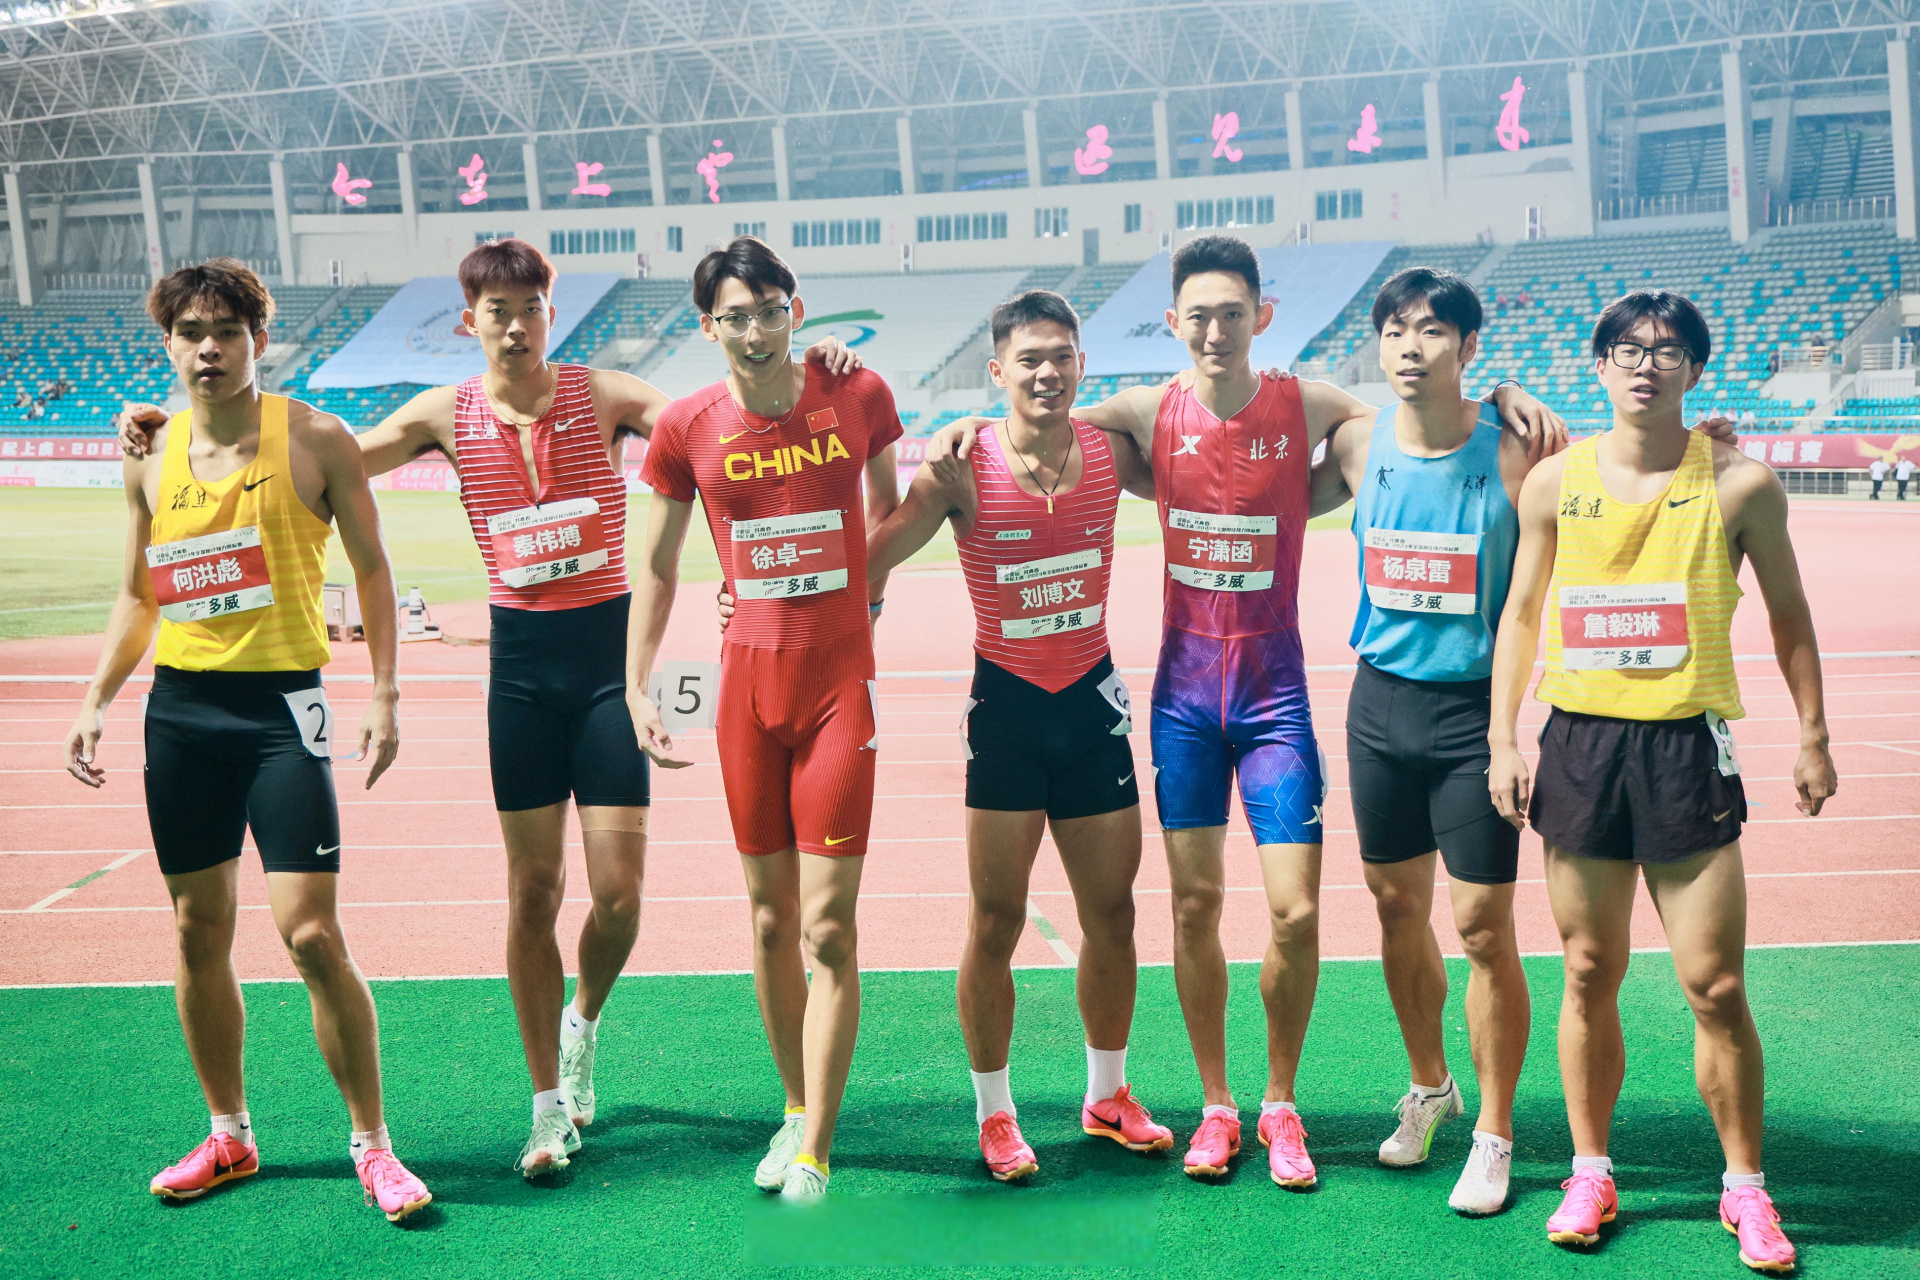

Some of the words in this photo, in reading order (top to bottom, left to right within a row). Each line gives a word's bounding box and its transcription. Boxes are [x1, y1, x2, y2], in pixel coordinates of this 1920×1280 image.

[463, 420, 500, 440] 上海
[724, 433, 850, 481] CHINA
[1250, 434, 1290, 461] 北京
[171, 484, 209, 511] 福建
[1462, 474, 1487, 499] 天津
[1560, 494, 1604, 518] 福建
[513, 524, 582, 558] 秦伟搏
[1187, 537, 1253, 564] 宁潇函
[550, 558, 580, 578] 多威
[751, 543, 823, 570] 徐卓一
[1382, 555, 1451, 584] 杨泉雷
[173, 557, 243, 593] 何洪彪
[787, 575, 819, 594] 多威
[1214, 573, 1245, 589] 多威
[209, 594, 240, 615] 多威
[1020, 578, 1086, 610] 刘博文
[1411, 593, 1443, 610] 多威
[1054, 612, 1083, 631] 多威
[1583, 612, 1660, 639] 詹毅琳
[1618, 649, 1652, 666] 多威
[674, 675, 701, 715] 5
[307, 702, 327, 743] 2
